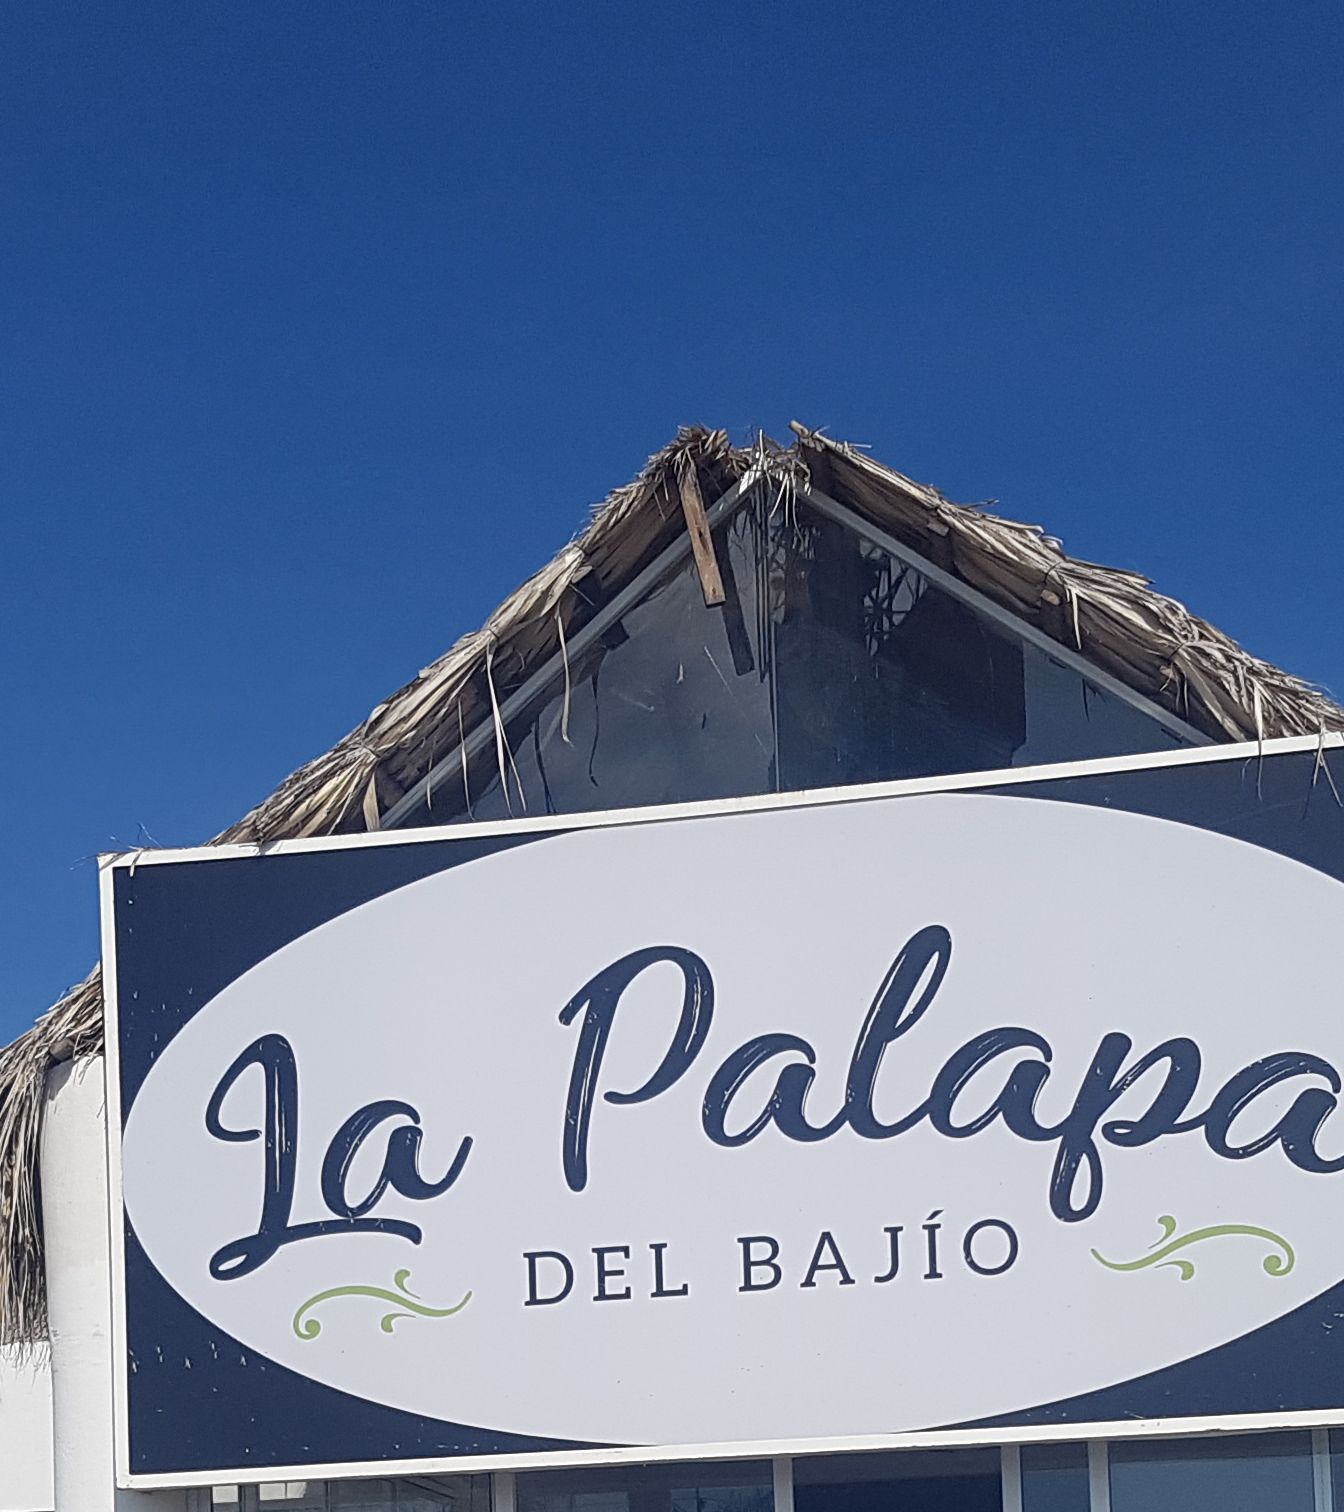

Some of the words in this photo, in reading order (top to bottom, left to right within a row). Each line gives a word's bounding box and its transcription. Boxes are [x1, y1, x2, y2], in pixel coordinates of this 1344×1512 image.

[205, 1033, 474, 1281] La
[522, 1242, 689, 1307] DEL
[737, 1208, 1019, 1292] BAJÍO
